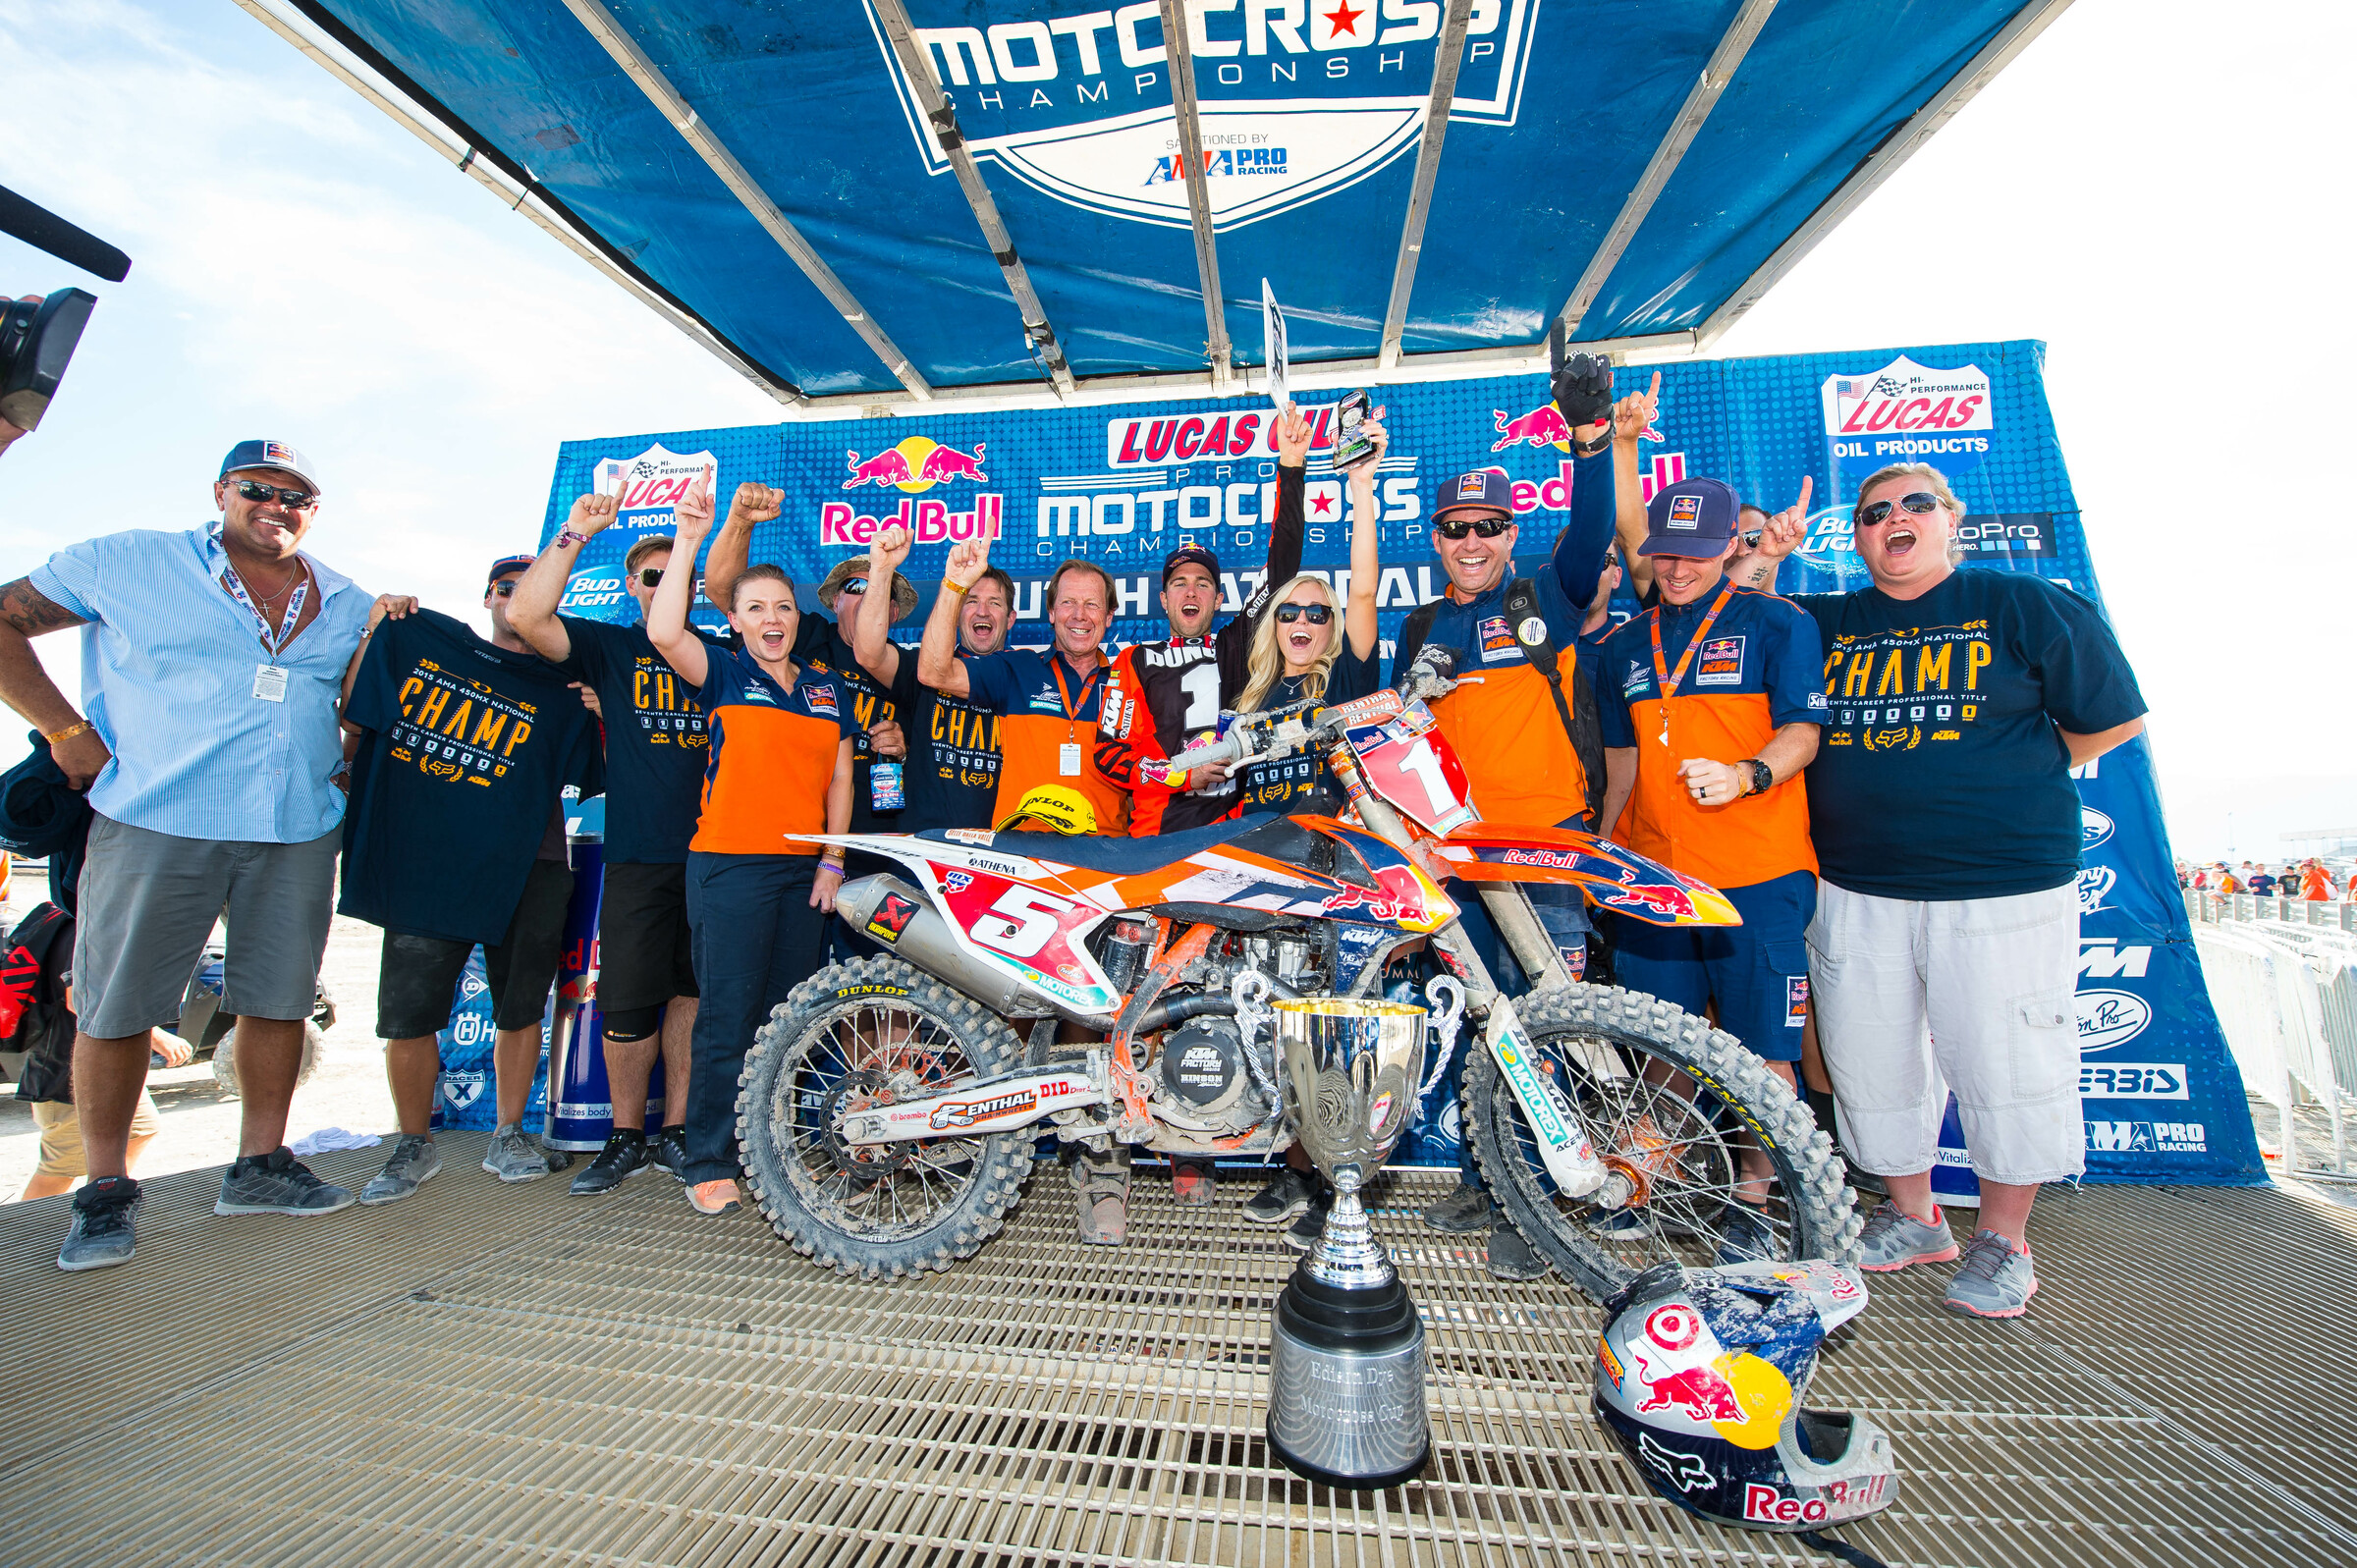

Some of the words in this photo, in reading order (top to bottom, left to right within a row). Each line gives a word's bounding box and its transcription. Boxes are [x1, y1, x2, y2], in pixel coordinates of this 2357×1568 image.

[943, 41, 1495, 110] CHAMPONSHIP
[1166, 134, 1246, 150] SATIONED
[1251, 134, 1269, 144] BY
[1236, 148, 1288, 166] PRO
[1237, 166, 1288, 176] RACING
[1910, 383, 1986, 394] PERFORMANCE
[1839, 395, 1984, 433] LUCAS
[1118, 413, 1260, 464] LUCAS
[1833, 442, 1869, 458] OIL
[1875, 438, 1989, 456] PRODUCTS
[660, 465, 715, 475] PERFORMANE
[1176, 462, 1276, 483] PRO
[621, 475, 712, 509] UCA
[822, 499, 912, 545] Red
[915, 494, 1003, 544] Bull
[1036, 524, 1423, 557] CHAMPIOSHIP
[1950, 522, 2040, 541] oPro
[1801, 537, 1855, 554] LIG
[571, 577, 622, 593] BUD
[559, 592, 626, 608] LIGHT
[1484, 635, 1516, 650] KTM
[1832, 642, 1852, 653] 2015
[1854, 641, 1878, 652] AMA
[1881, 638, 1920, 647] 450MX
[1924, 631, 1990, 643] NATIONAL
[1145, 645, 1217, 669] DUNG
[1701, 660, 1737, 674] KTM
[1824, 640, 1992, 697] CHAMP
[412, 668, 434, 681] 2015
[436, 677, 457, 691] AMA
[459, 687, 489, 704] 450MX
[491, 700, 535, 724] NATIONAL
[1181, 662, 1221, 730] 1
[1342, 691, 1395, 714] RENTHAL
[1888, 694, 1955, 704] PROFESSIONAL
[399, 676, 531, 757] CHAMP
[1101, 687, 1124, 736] KTM
[1124, 698, 1135, 730] ATHENA
[932, 703, 1002, 752] CHAM
[1931, 730, 1961, 740] KTM
[420, 730, 447, 742] CAREER
[448, 739, 495, 760] PROFESSIONAL
[1269, 755, 1310, 766] PROFESSIONAL
[1398, 736, 1457, 818] 1
[976, 859, 1016, 876] ATHENA
[968, 884, 1076, 958] 5
[837, 985, 909, 1000] DUNLOP
[1039, 975, 1096, 1007] MOTOREX
[2096, 1000, 2135, 1028] Pro
[1183, 1047, 1218, 1059] KTM
[1180, 1059, 1223, 1068] FACTORY
[1180, 1074, 1224, 1083] HINSON
[2078, 1068, 2180, 1093] ERBIS
[453, 1083, 472, 1101] X
[557, 1103, 586, 1117] Vitalizes
[588, 1105, 612, 1118] body
[976, 1104, 1035, 1121] CHAINWHEELS
[1509, 1063, 1565, 1142] MOTOREX
[1686, 1063, 1776, 1150] DUNLOP
[899, 1110, 927, 1121] brembo
[2153, 1122, 2205, 1142] PRO
[1938, 1150, 1973, 1164] Vitaliz
[2158, 1142, 2208, 1153] RACING
